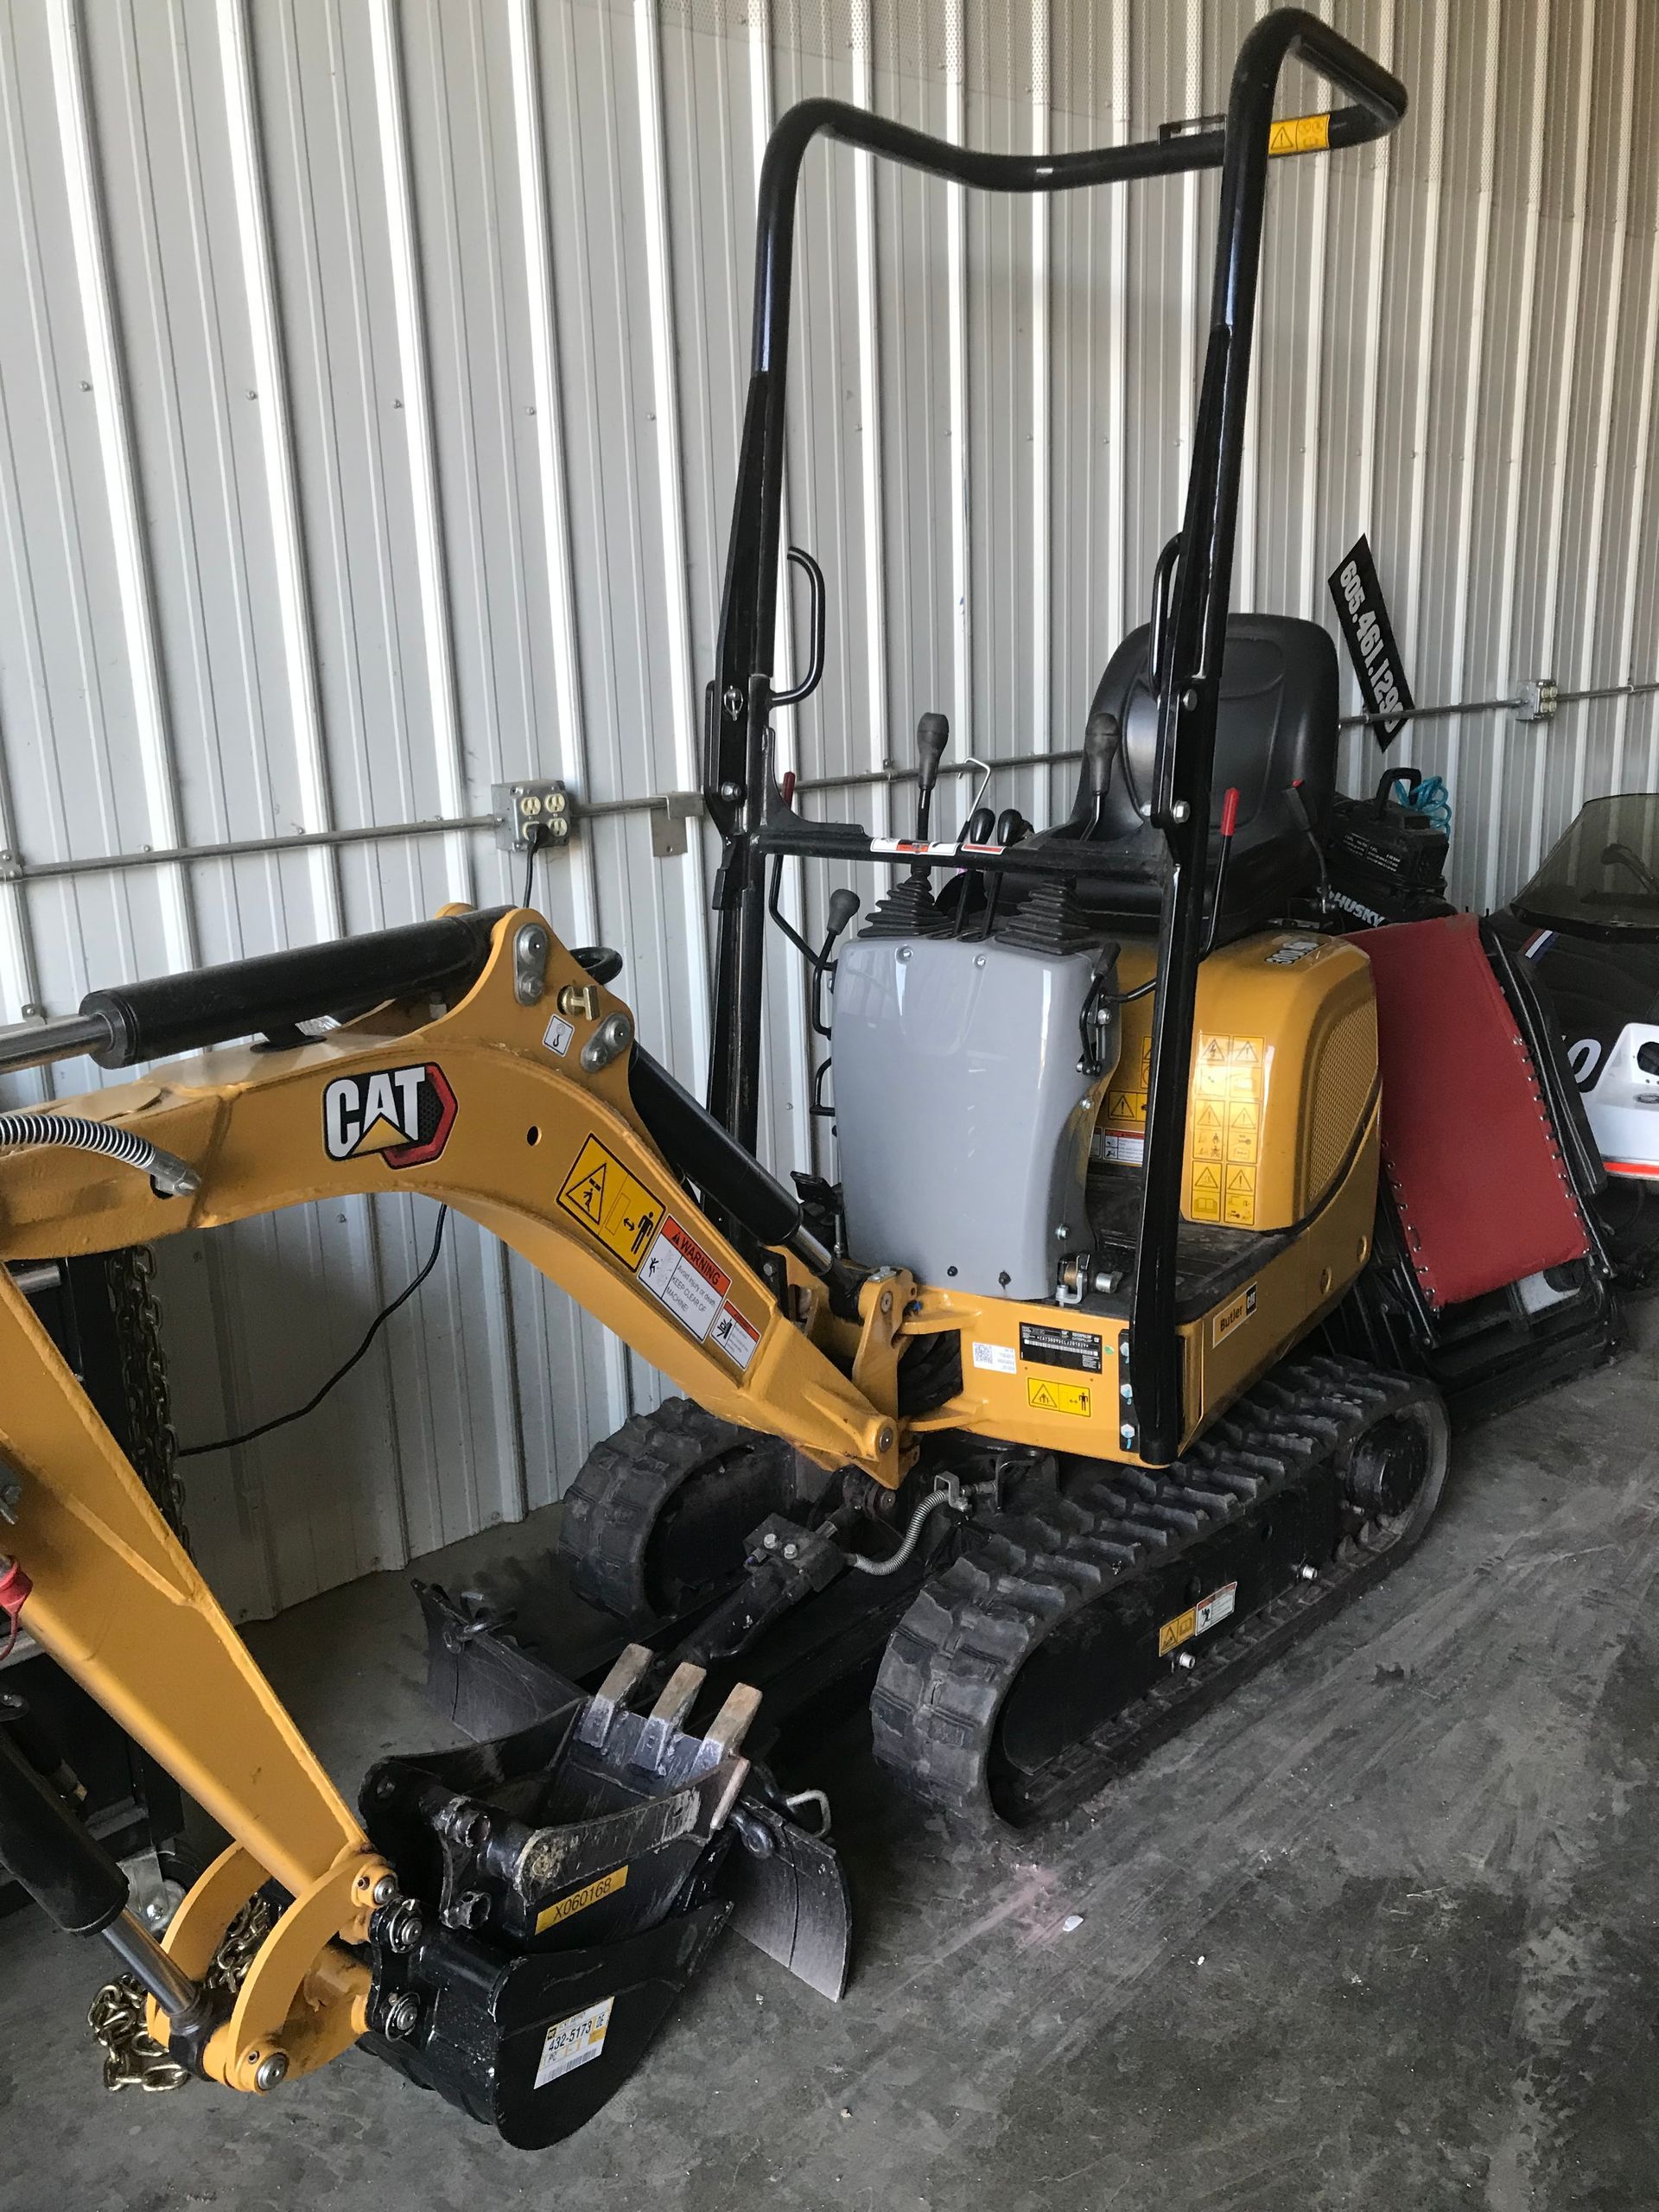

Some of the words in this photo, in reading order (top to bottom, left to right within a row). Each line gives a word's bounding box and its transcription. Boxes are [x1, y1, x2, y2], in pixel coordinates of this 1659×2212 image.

[1333, 891, 1386, 928] HUSKY
[326, 1066, 426, 1158] CAT
[681, 1236, 721, 1287] WARNING
[671, 1275, 686, 1291] KEEP
[683, 1287, 700, 1307] CLEAR
[698, 1301, 708, 1313] OF
[1220, 1306, 1243, 1332] Butler
[553, 1877, 612, 1922] X060168
[548, 2020, 593, 2052] 432-5173
